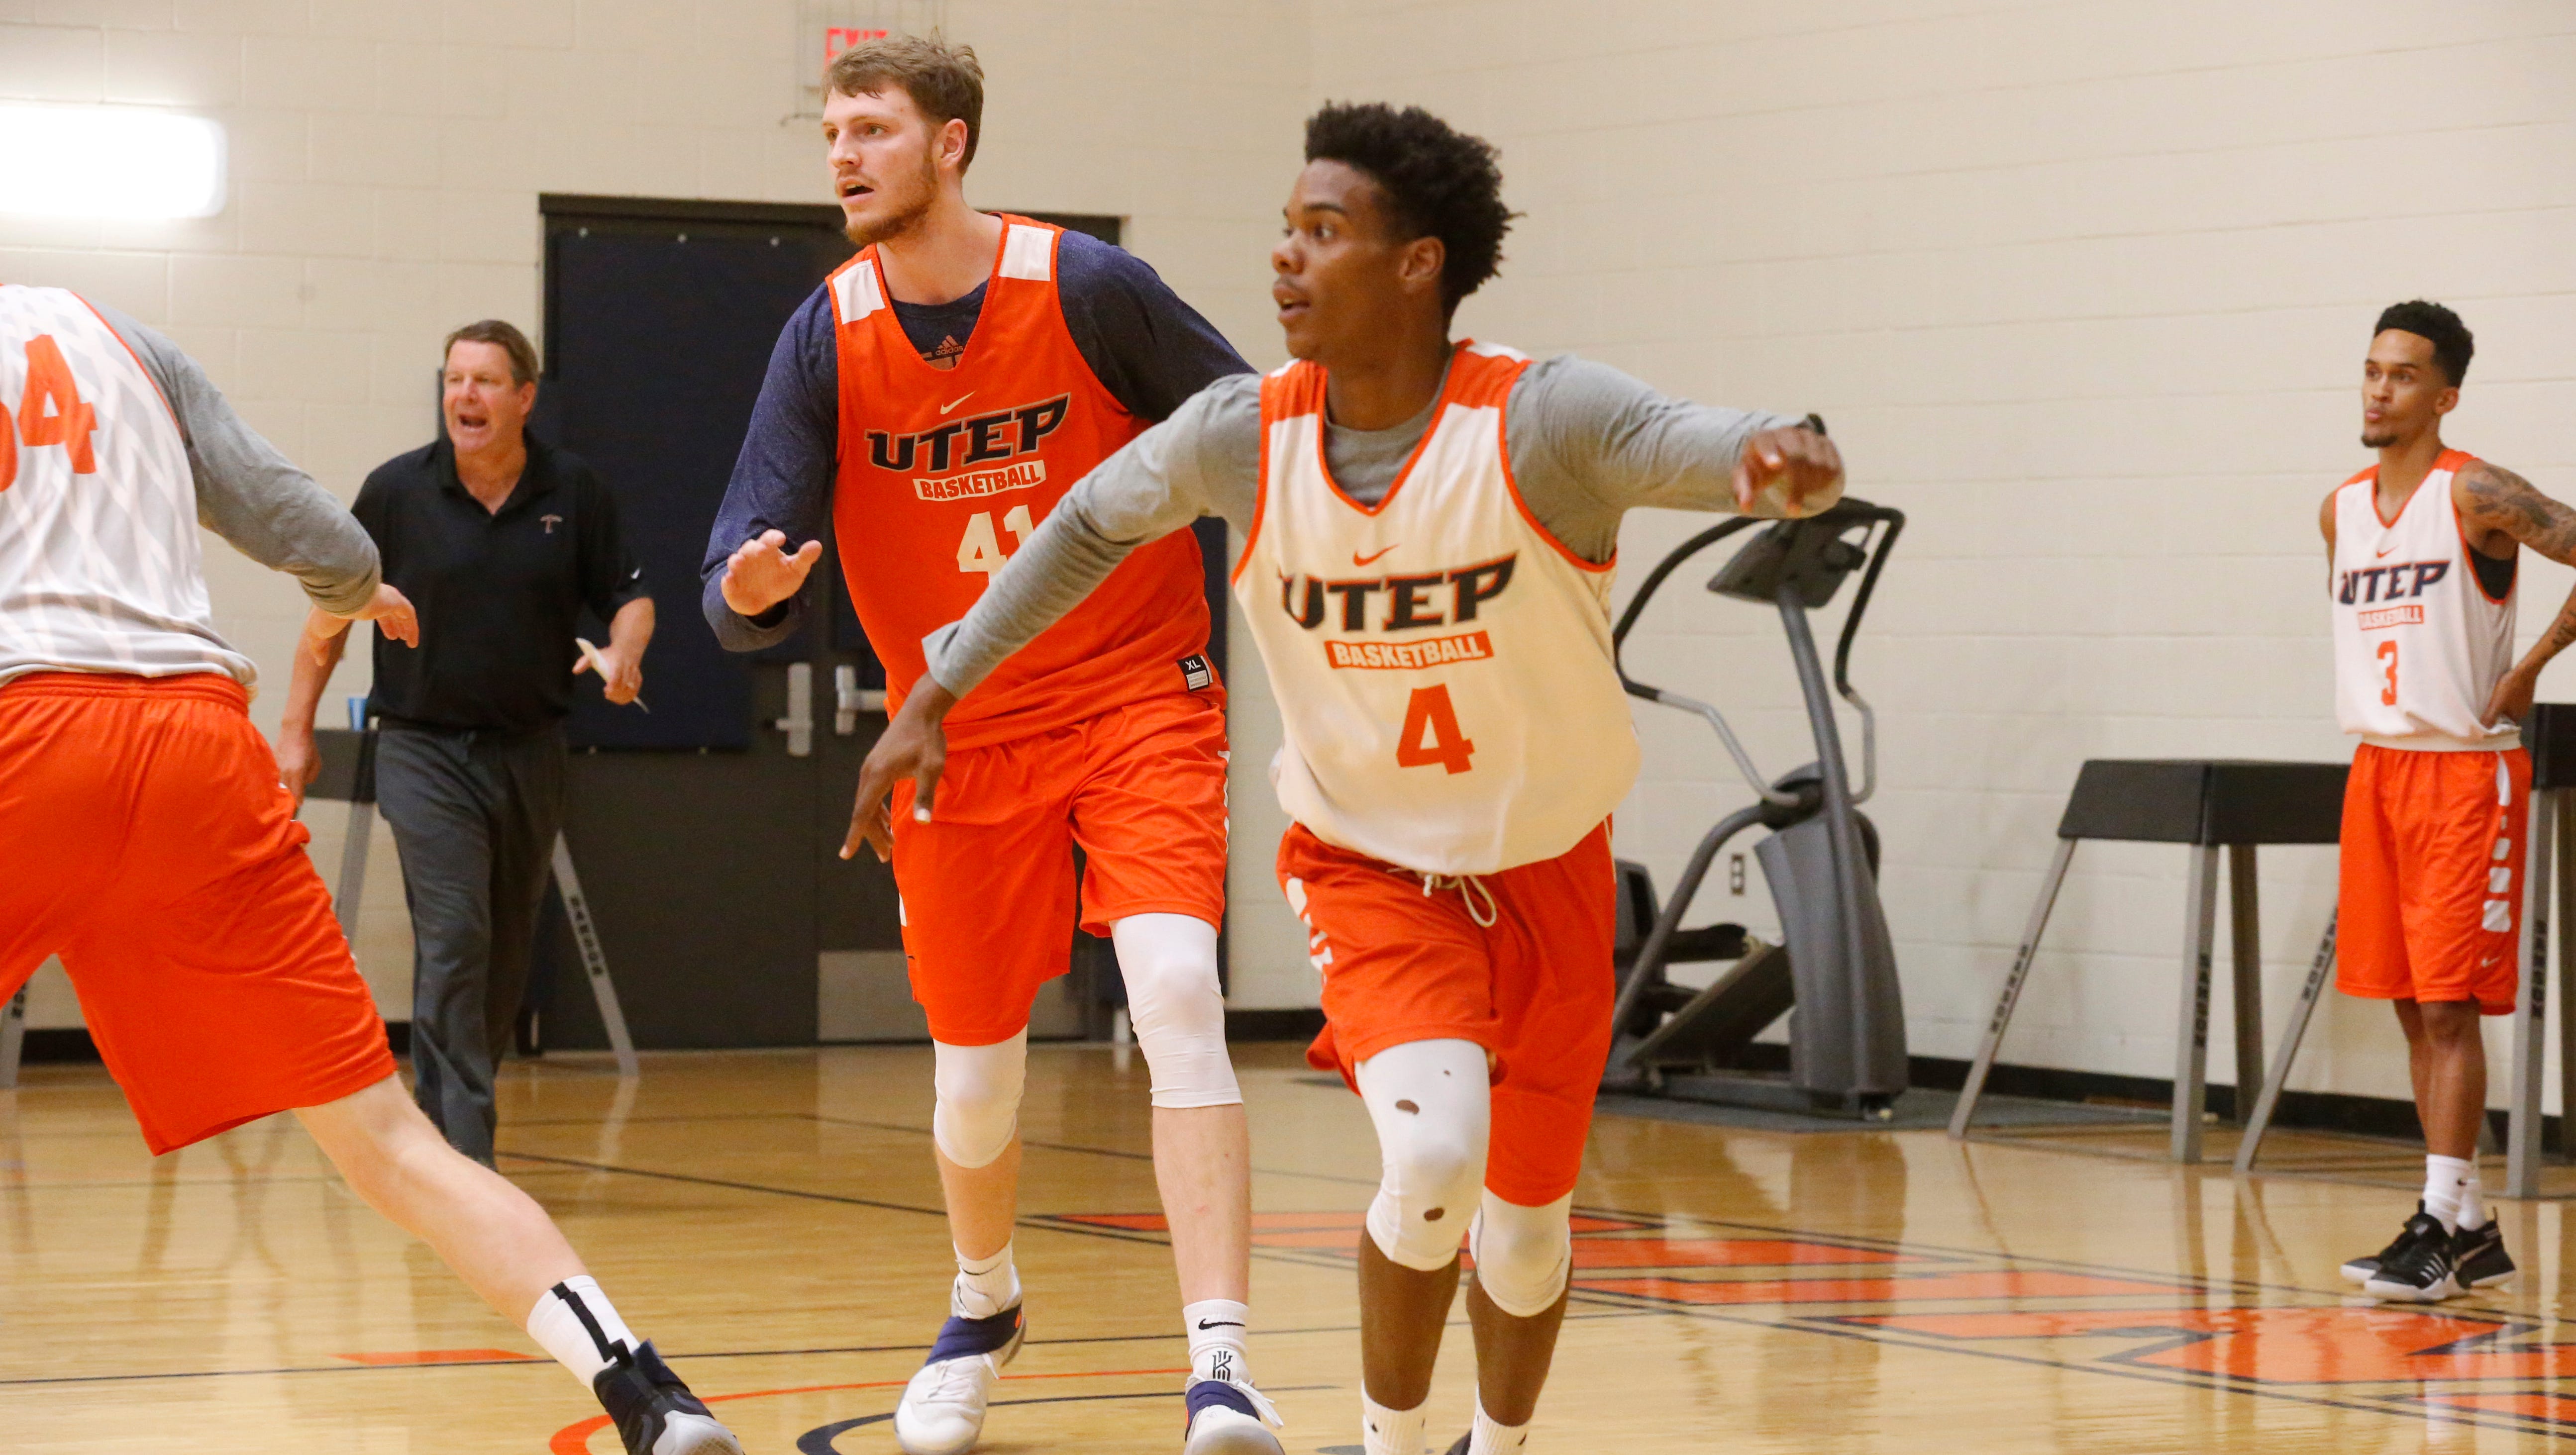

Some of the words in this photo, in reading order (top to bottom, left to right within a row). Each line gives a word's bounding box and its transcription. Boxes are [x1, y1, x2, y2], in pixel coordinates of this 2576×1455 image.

[935, 345, 964, 356] adidas
[864, 392, 1070, 472] UTEP
[920, 466, 1041, 499] BASKETBALL
[1278, 550, 1519, 631] UTEP
[1185, 659, 1201, 671] XL
[1333, 635, 1485, 668] BASKETBALL
[2377, 640, 2398, 706] 3
[1396, 683, 1475, 775] 4
